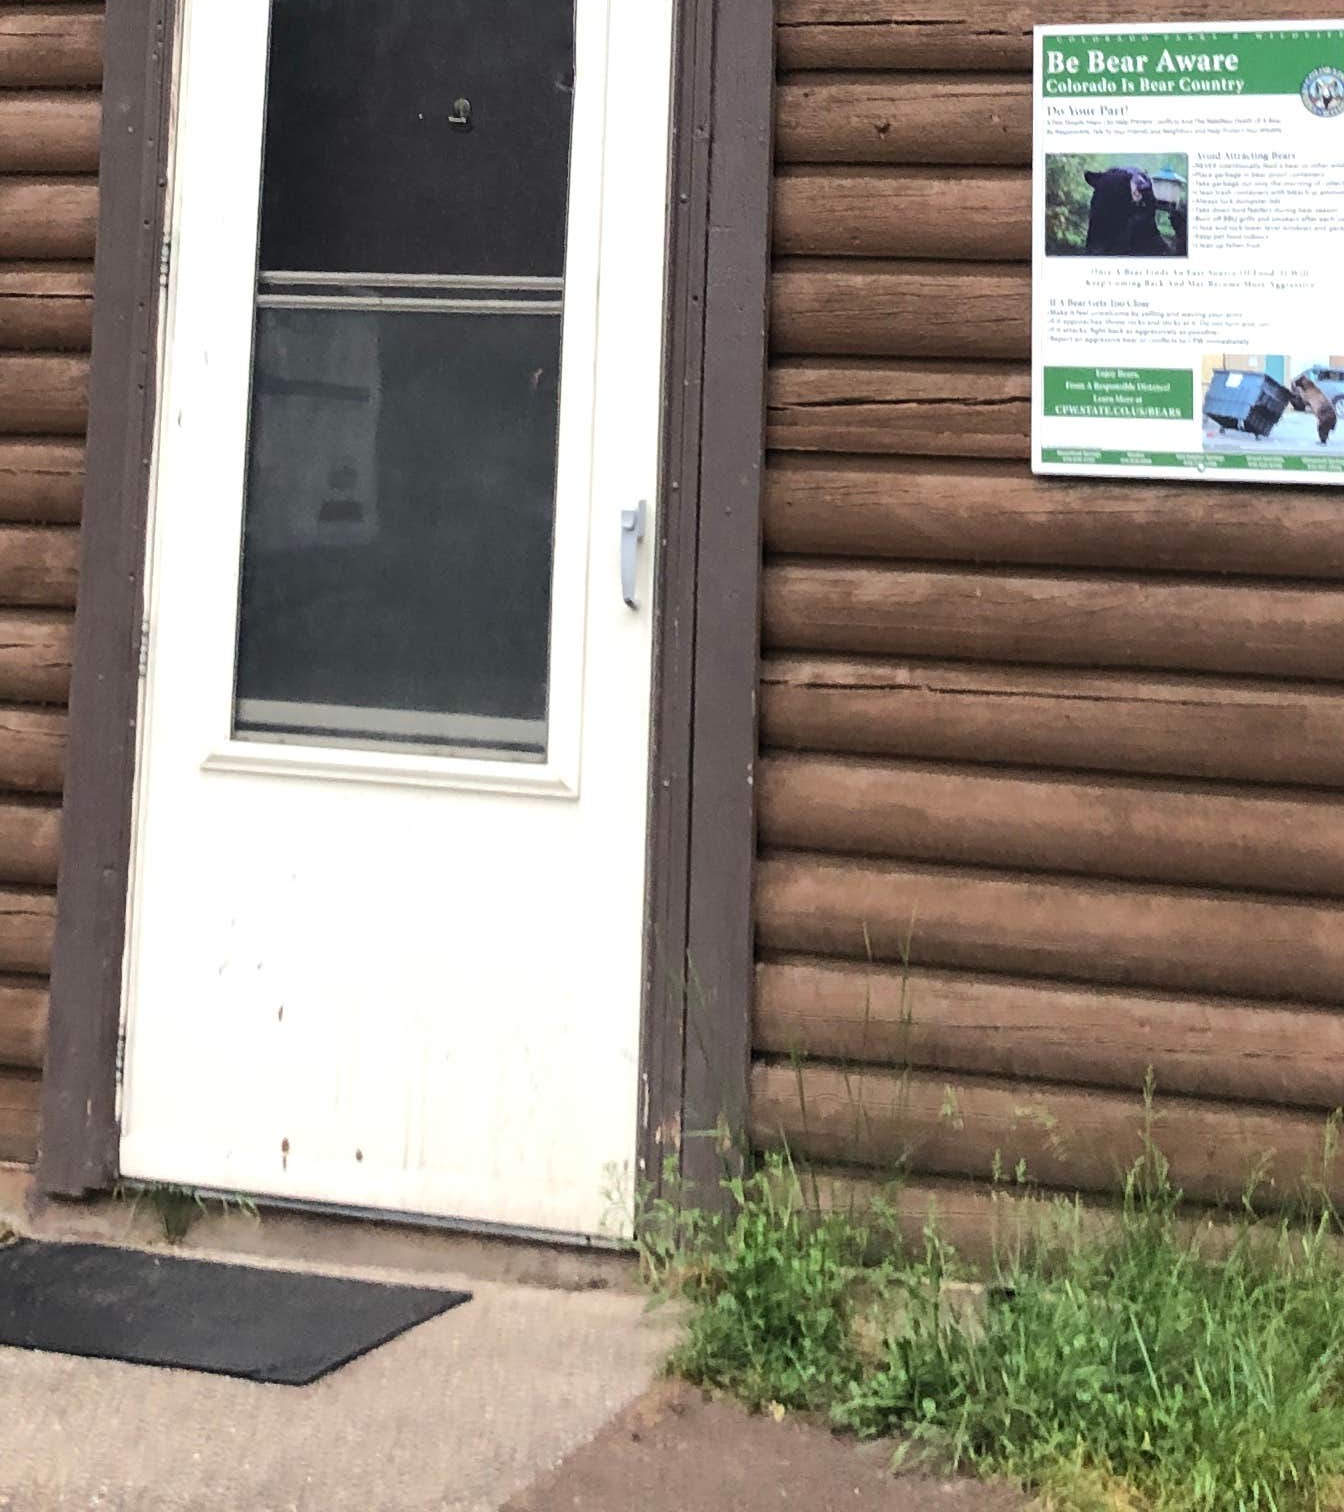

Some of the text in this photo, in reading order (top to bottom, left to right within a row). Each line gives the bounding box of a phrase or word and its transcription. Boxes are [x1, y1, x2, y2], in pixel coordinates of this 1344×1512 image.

[1046, 48, 1240, 74] Be Bear Aware
[1046, 77, 1245, 95] Colorado Is Bear Country
